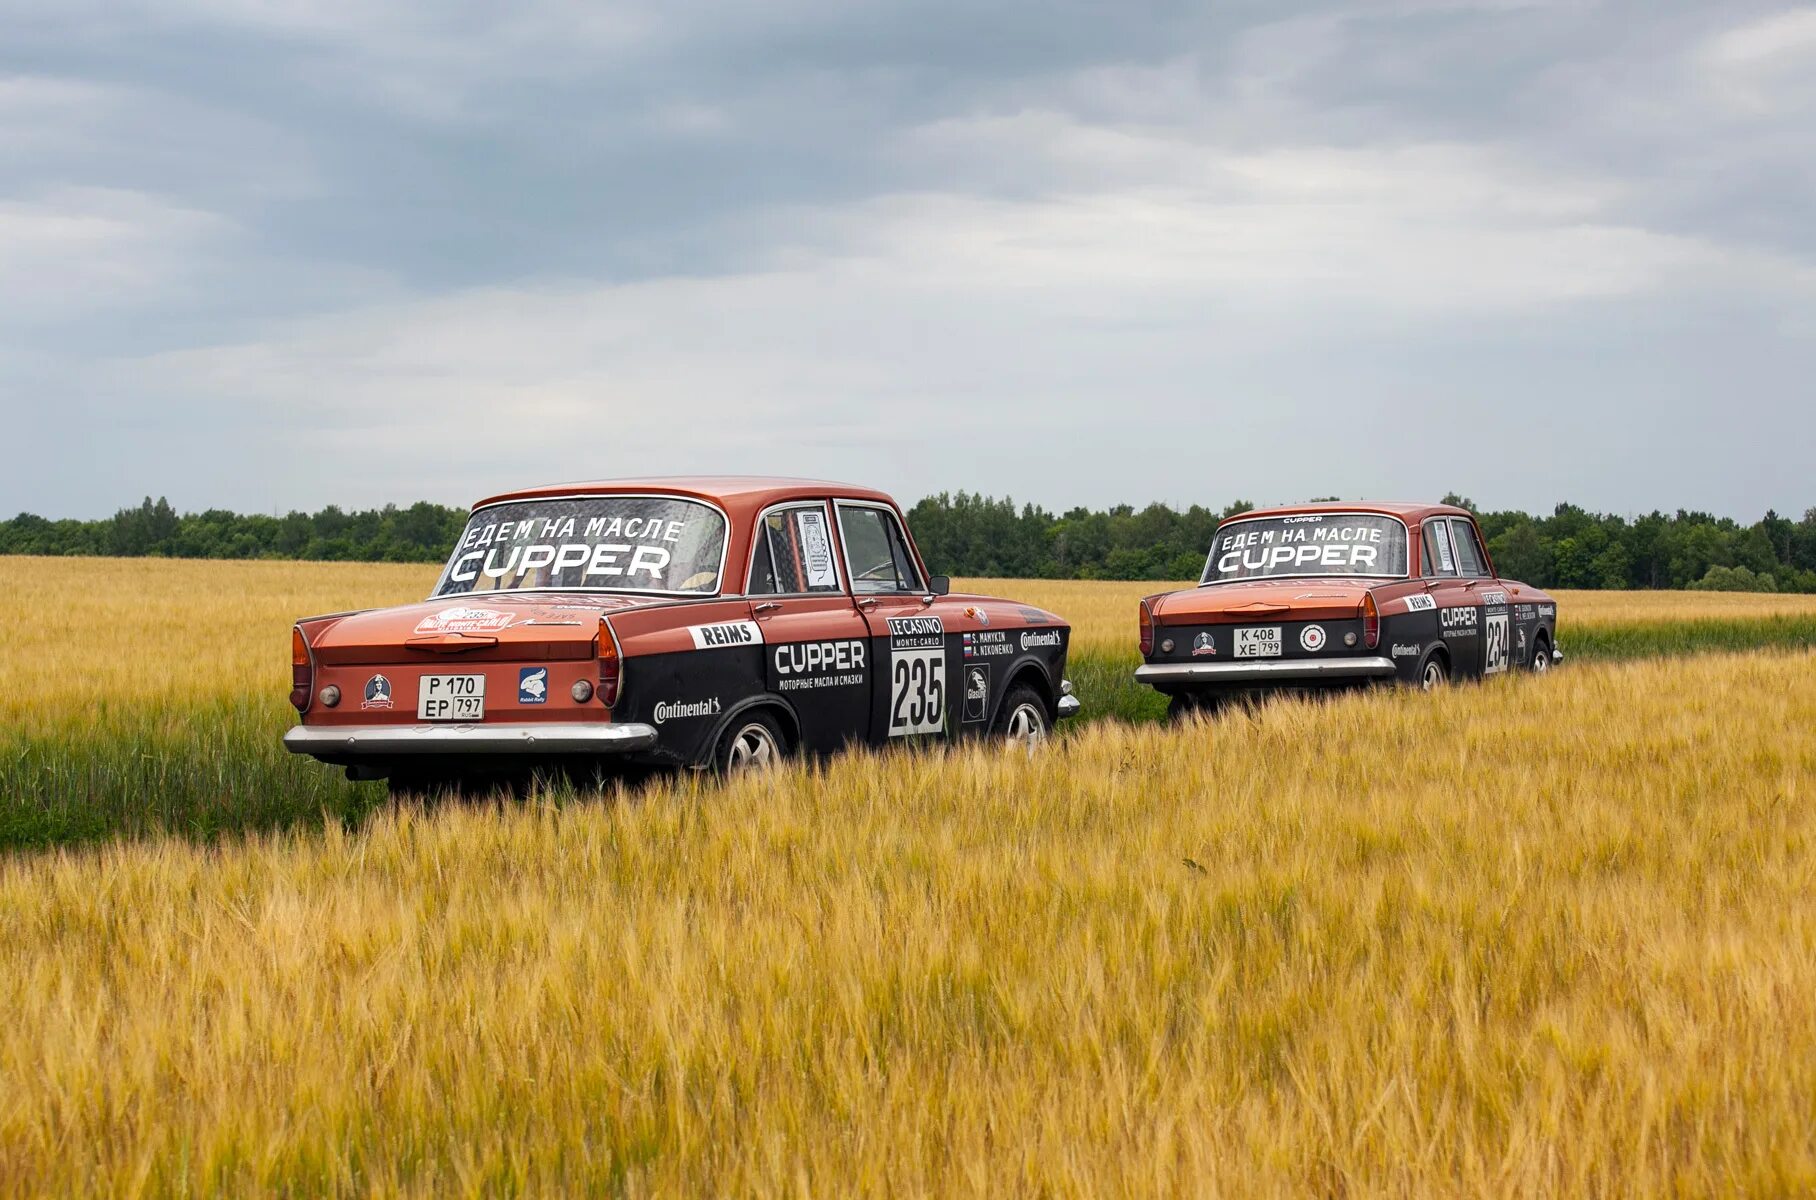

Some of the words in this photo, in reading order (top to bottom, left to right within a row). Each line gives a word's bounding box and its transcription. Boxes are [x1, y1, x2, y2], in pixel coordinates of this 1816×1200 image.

[1283, 516, 1323, 524] CUPPER
[463, 519, 535, 549] ЕДЕМ
[540, 518, 575, 538] НА
[583, 517, 684, 543] МАСЛЕ
[1221, 530, 1275, 551] ЕДЕМ
[1281, 529, 1306, 543] НА
[1312, 527, 1383, 543] МАСЛЕ
[450, 543, 671, 582] CUPPER
[1217, 544, 1378, 573] CUPPER
[1409, 596, 1432, 610] REIMS
[901, 618, 941, 635] CASINO
[1441, 606, 1478, 627] CUPPER
[700, 624, 752, 646] REIMS
[1020, 630, 1056, 651] Continental
[1253, 629, 1275, 640] 408
[1486, 620, 1508, 668] 234
[774, 640, 865, 674] CUPPER
[1261, 642, 1280, 652] 799
[429, 677, 440, 695] Р
[446, 677, 475, 695] 170
[779, 678, 814, 690] МОТОРНЫЕ
[814, 676, 834, 688] МАСЛА
[834, 676, 839, 685] И
[839, 674, 863, 686] СМАЗКИ
[892, 657, 943, 728] 235
[425, 700, 449, 717] ЕР
[456, 698, 481, 713] 797
[653, 698, 712, 725] Continental
